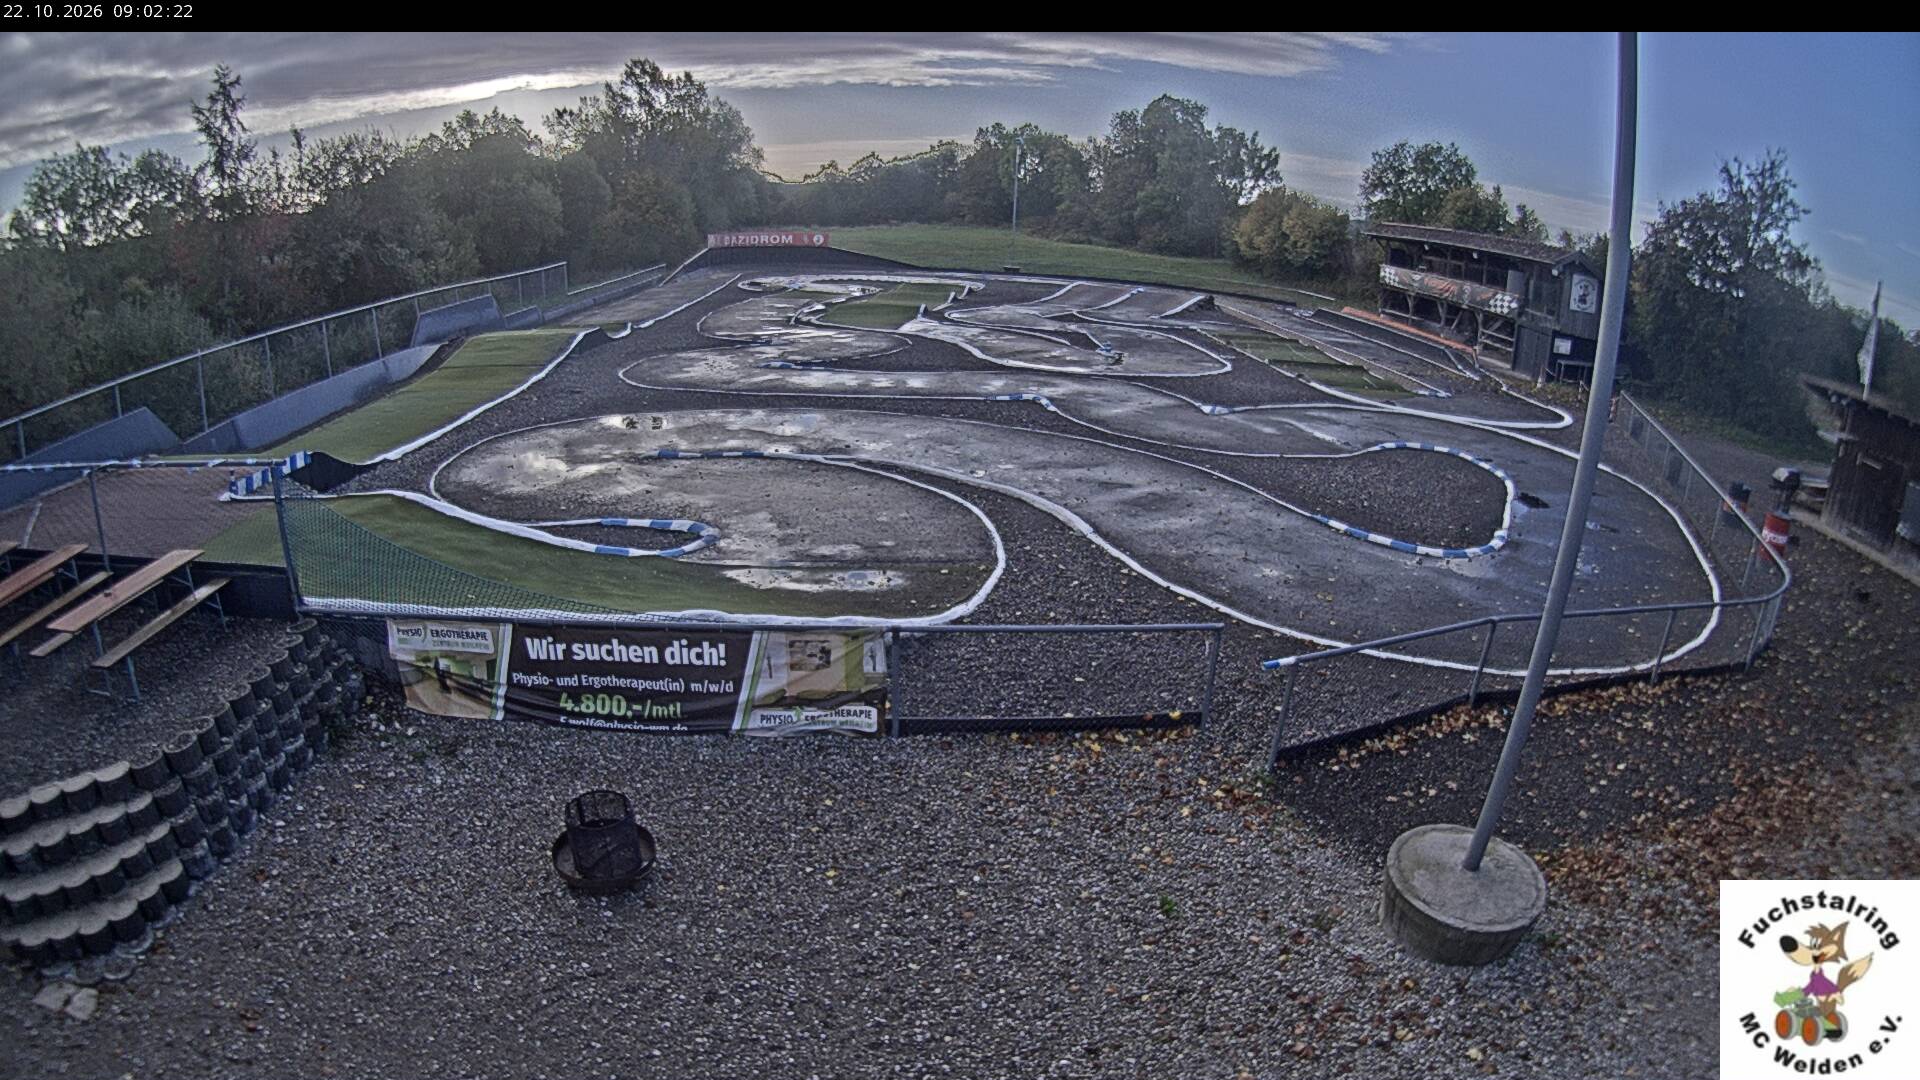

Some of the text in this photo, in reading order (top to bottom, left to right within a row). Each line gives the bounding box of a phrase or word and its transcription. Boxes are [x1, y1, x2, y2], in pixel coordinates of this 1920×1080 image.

[430, 629, 489, 641] ERGOTHERAPIE
[525, 636, 727, 666] Wir suchen dich!
[512, 672, 734, 693] Physio- und Ergotherapeut(in) m/w/d
[760, 714, 794, 725] PHYSIO
